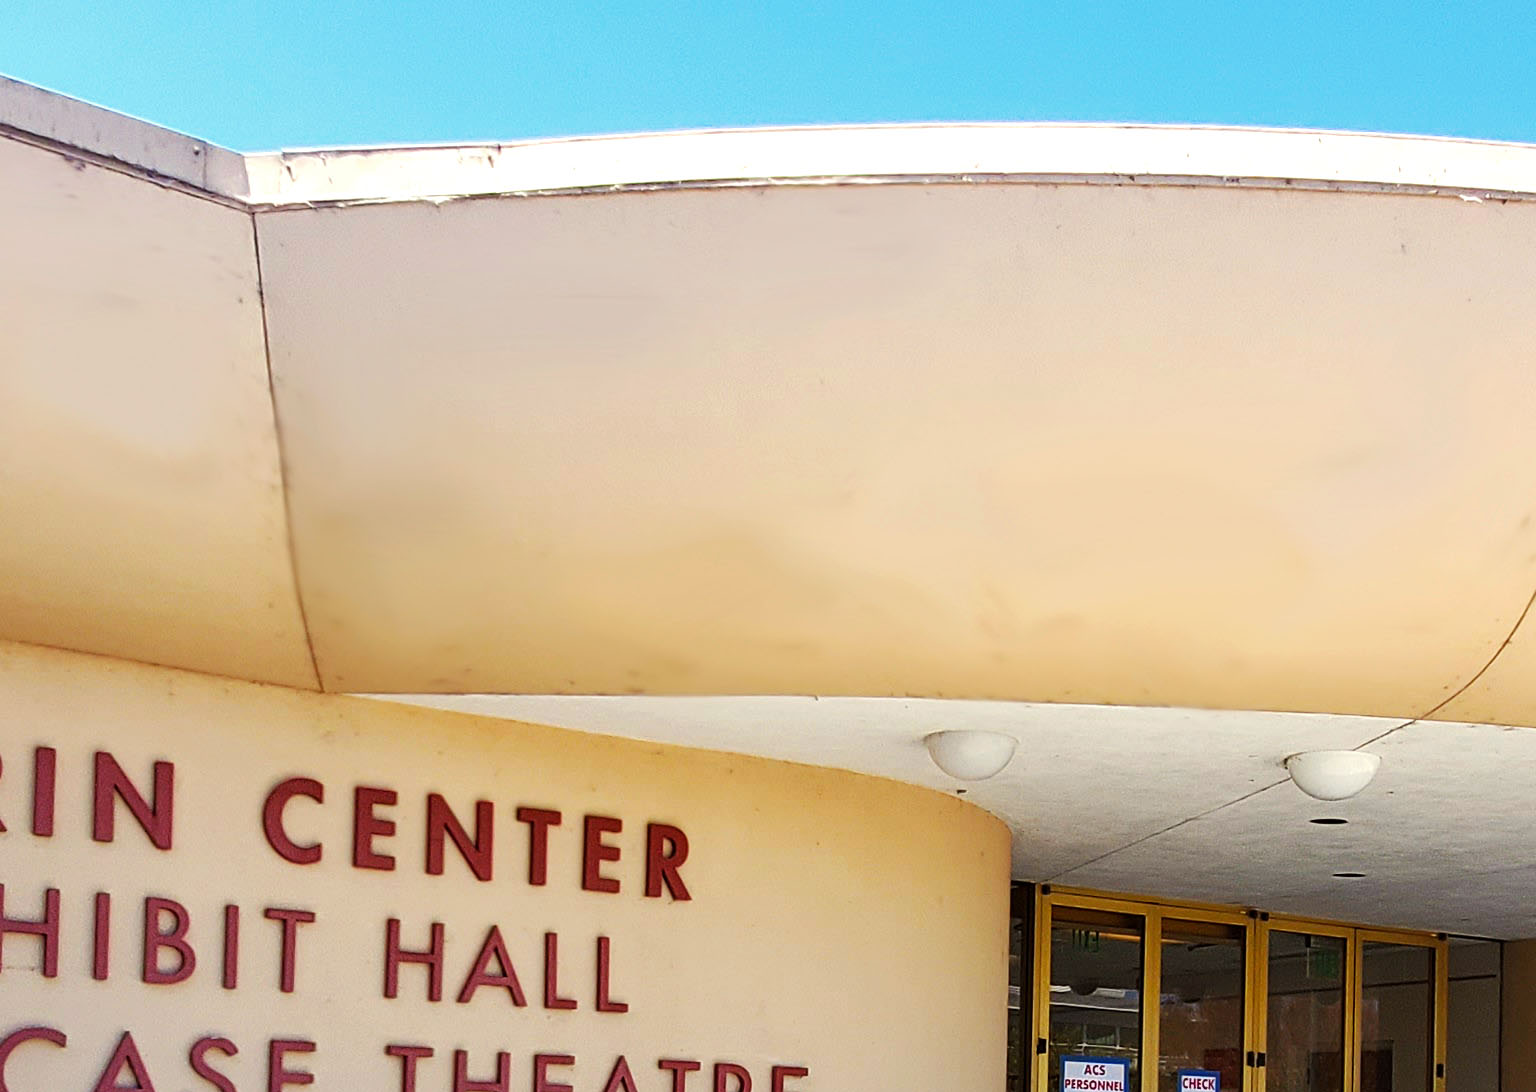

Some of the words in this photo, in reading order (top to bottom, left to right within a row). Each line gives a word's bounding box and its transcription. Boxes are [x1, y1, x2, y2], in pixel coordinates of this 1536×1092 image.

[260, 775, 694, 902] CENTER
[382, 917, 629, 1014] HALL
[1084, 1064, 1106, 1076] ACS
[1064, 1079, 1124, 1092] PERSONNEL
[1182, 1077, 1215, 1090] CHECK
